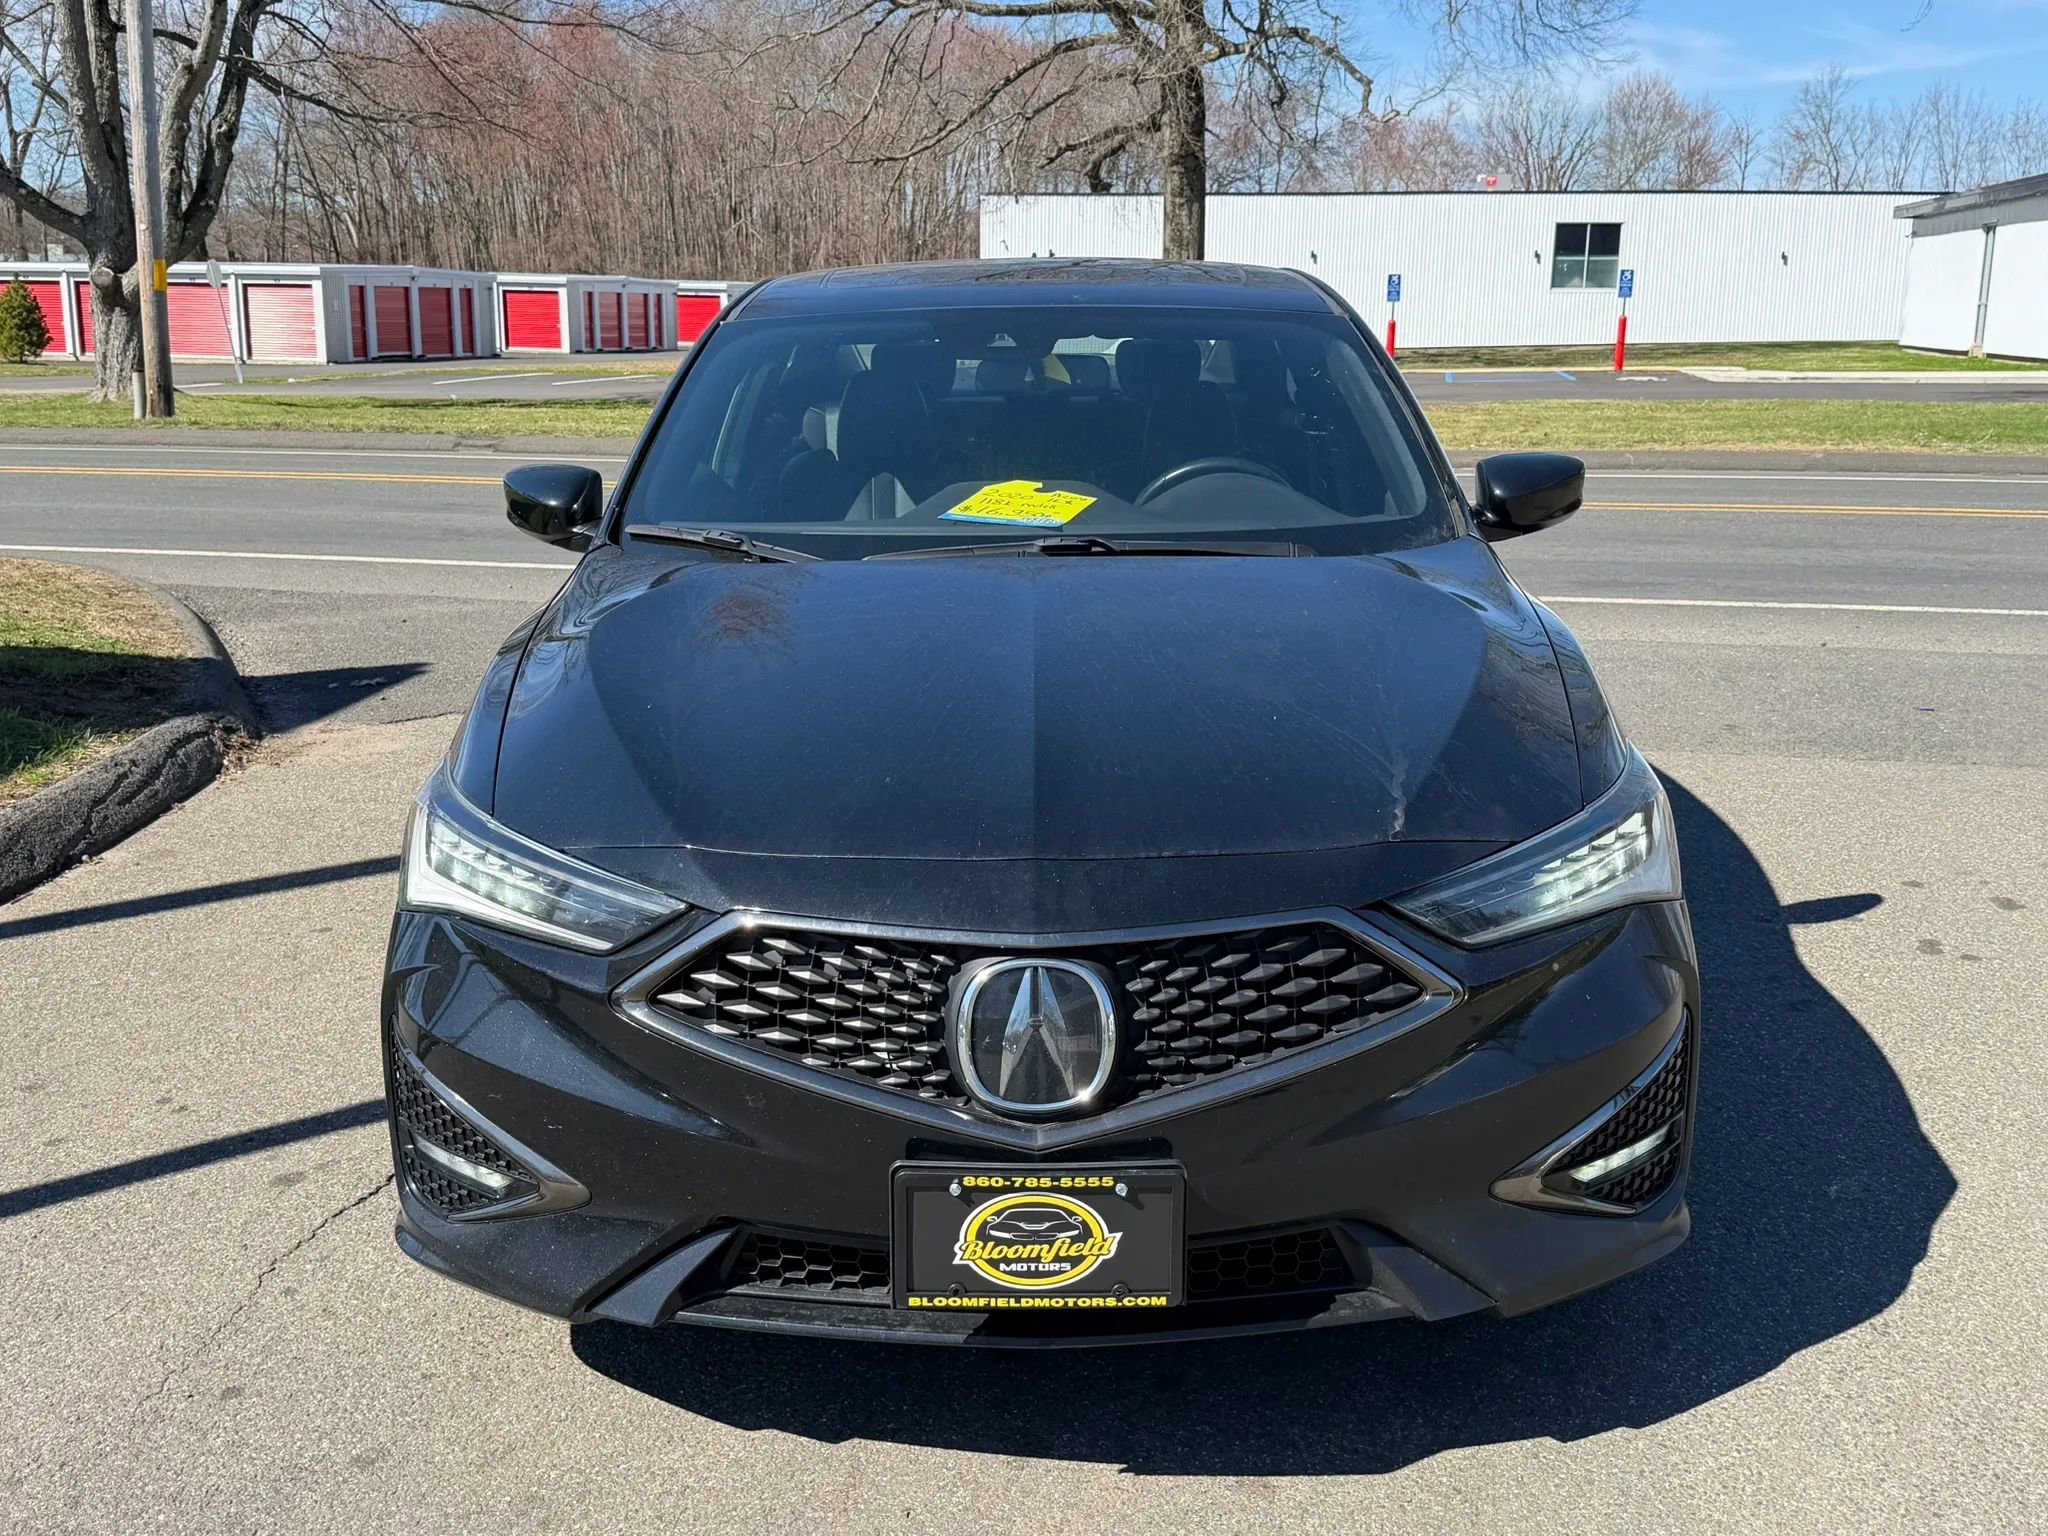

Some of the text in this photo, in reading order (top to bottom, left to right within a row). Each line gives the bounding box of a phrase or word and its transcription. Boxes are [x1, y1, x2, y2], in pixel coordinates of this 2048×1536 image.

[982, 489, 1034, 500] 2020
[962, 1176, 1115, 1187] 860-785-5555
[960, 1236, 1116, 1263] Bloomfield
[999, 1262, 1072, 1272] MOTORS
[908, 1296, 1168, 1308] BLOOMFIELDMOTORS.COM
